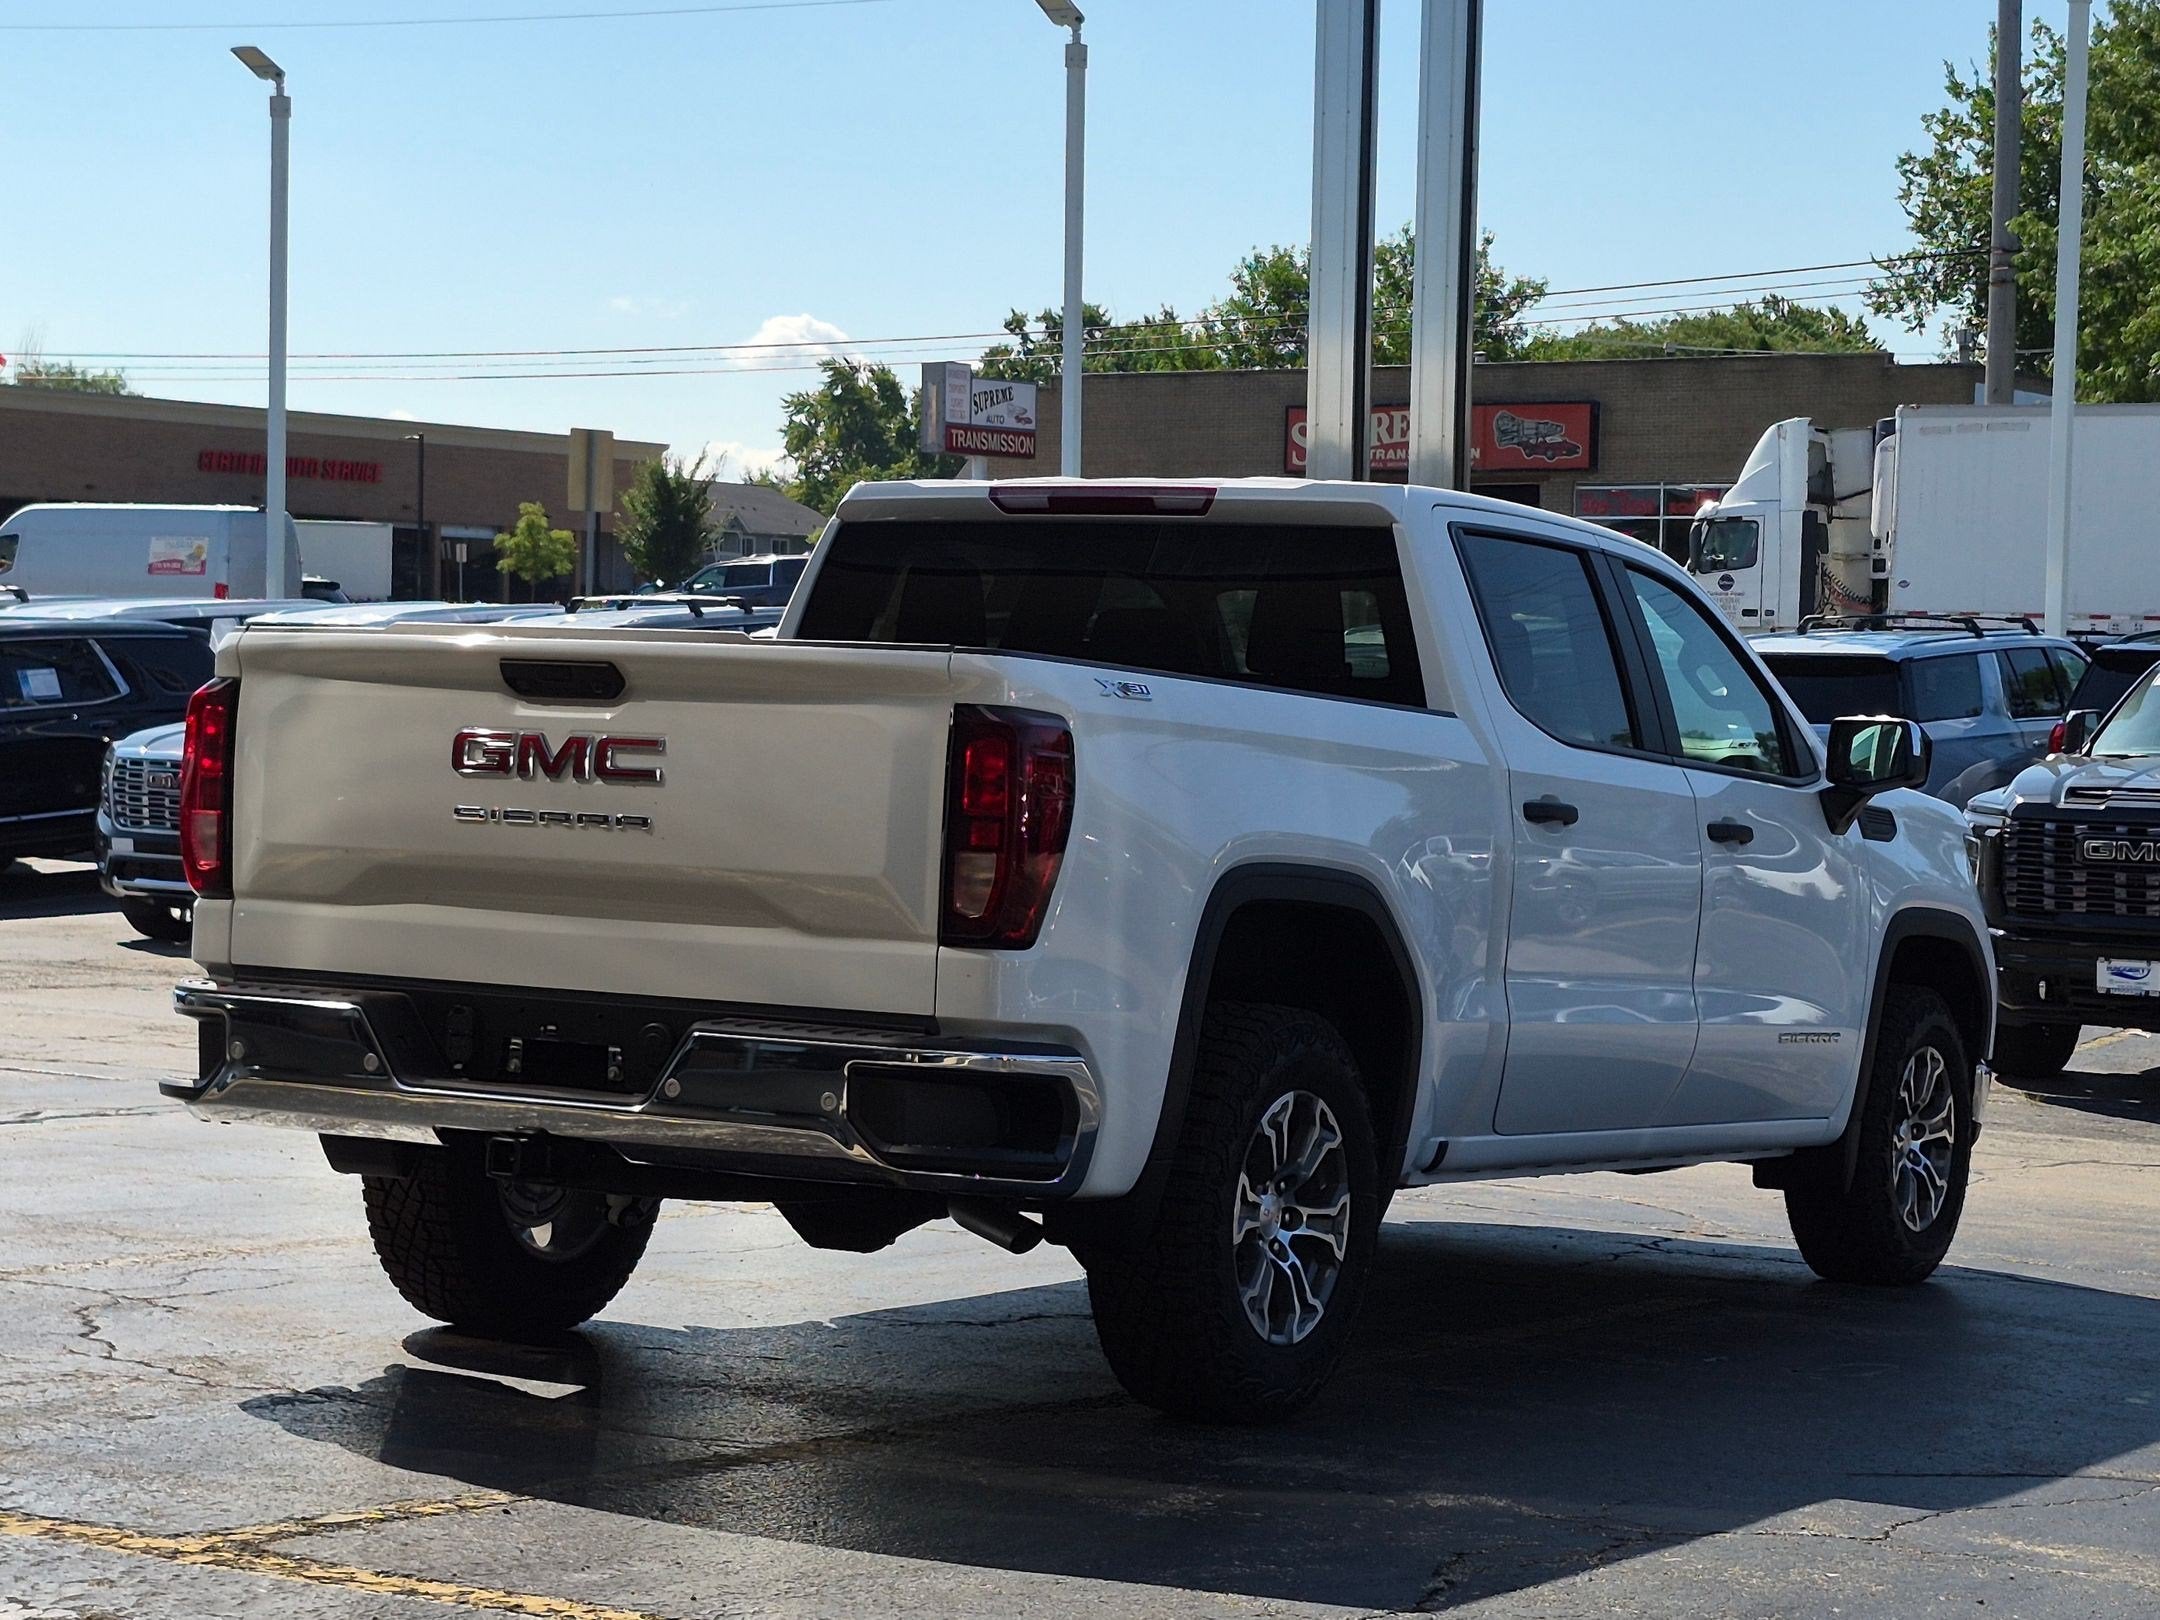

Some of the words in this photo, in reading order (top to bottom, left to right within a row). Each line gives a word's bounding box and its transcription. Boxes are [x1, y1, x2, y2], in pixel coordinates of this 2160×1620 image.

[973, 386, 1014, 415] SUPREME
[986, 414, 1005, 425] AUTO
[951, 429, 1034, 455] TRANSMISSION
[321, 459, 384, 483] SERVICE
[1094, 678, 1152, 701] X31
[452, 727, 666, 785] GMC
[148, 773, 182, 788] GM
[453, 804, 651, 830] SIERRA
[2083, 840, 2160, 862] GM
[1779, 1032, 1841, 1044] SIERRA
